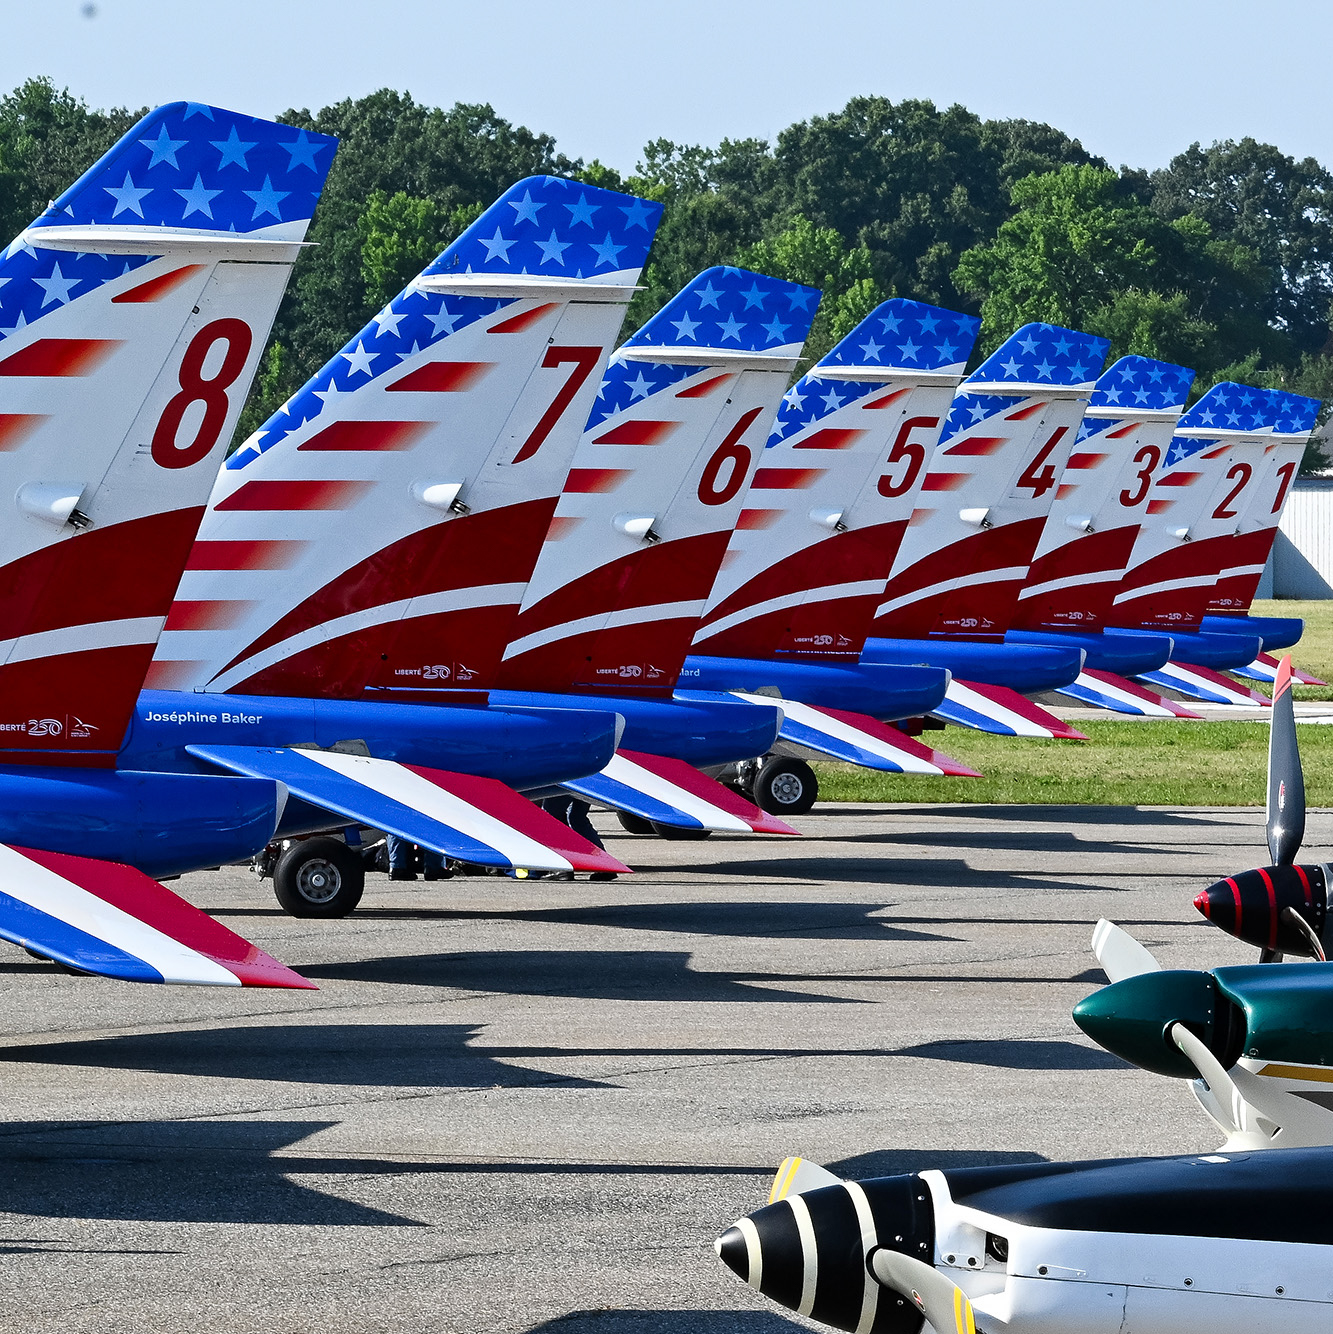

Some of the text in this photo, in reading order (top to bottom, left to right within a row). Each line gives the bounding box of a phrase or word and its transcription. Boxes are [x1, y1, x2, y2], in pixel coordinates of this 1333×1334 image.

[151, 317, 253, 470] 8
[511, 346, 604, 465] 7
[697, 406, 764, 506] 6
[877, 416, 940, 499] 5
[1016, 426, 1069, 498] 4
[1120, 445, 1160, 507] 3
[1211, 462, 1254, 520] 2
[1271, 461, 1297, 514] 1
[395, 668, 421, 676] LIBERTÉ
[423, 664, 451, 679] 250
[619, 665, 643, 678] 250
[679, 668, 700, 677] lard
[28, 718, 63, 737] 250
[145, 711, 263, 726] Joséphine Baker
